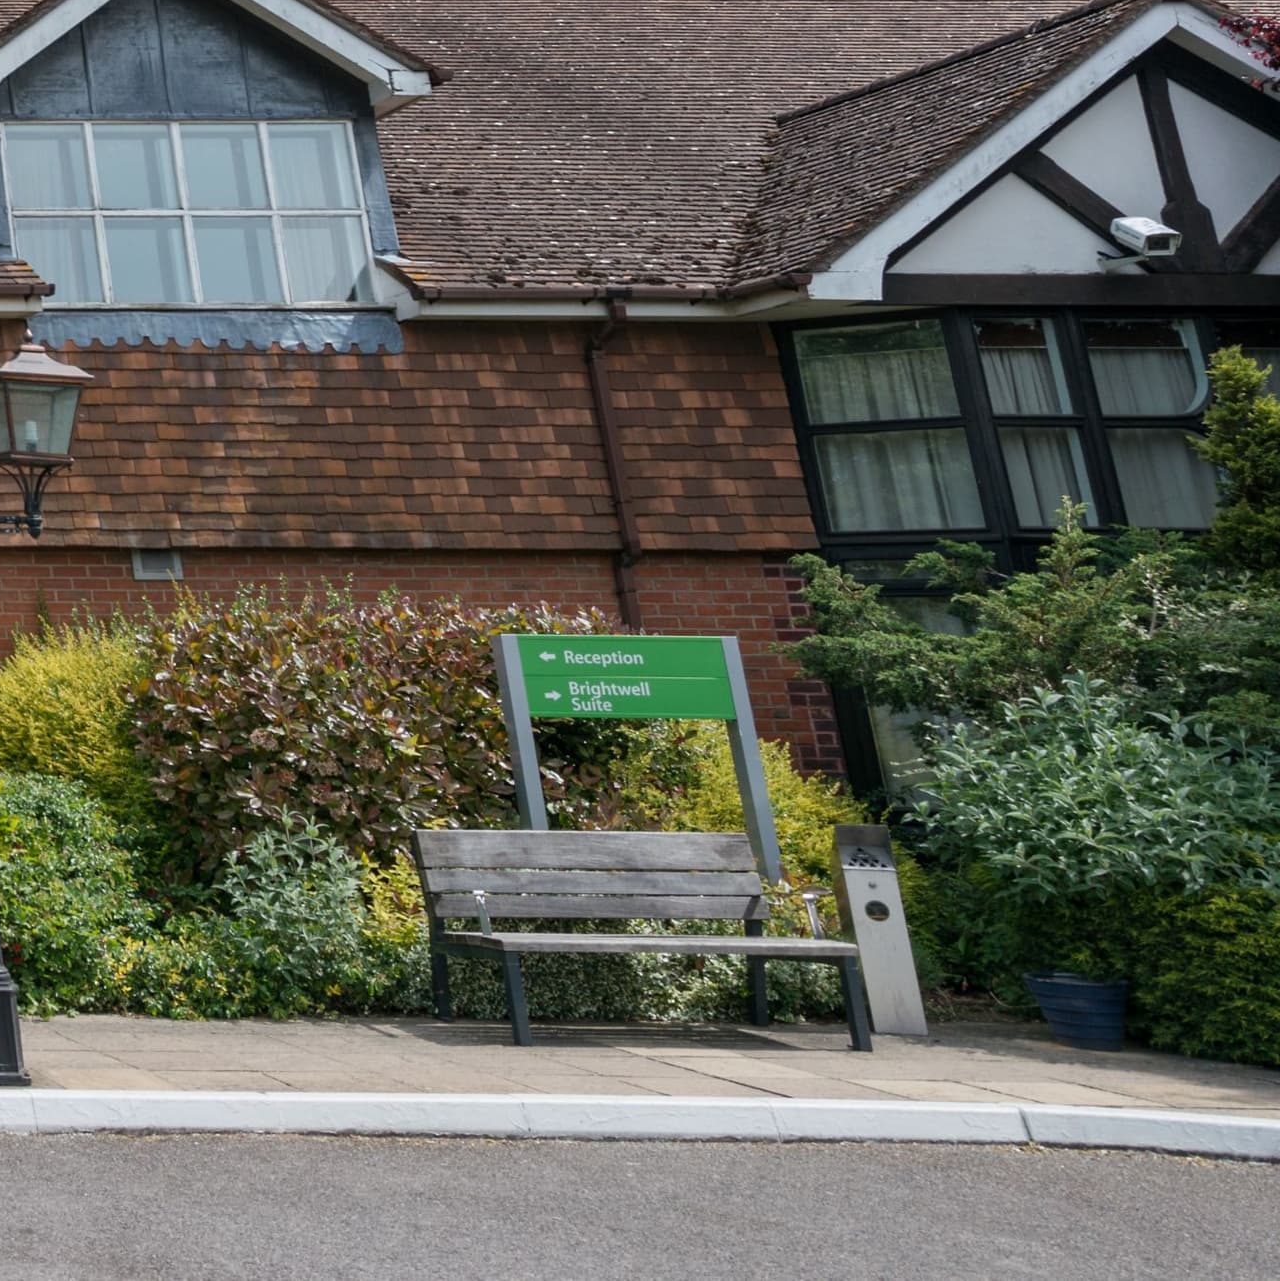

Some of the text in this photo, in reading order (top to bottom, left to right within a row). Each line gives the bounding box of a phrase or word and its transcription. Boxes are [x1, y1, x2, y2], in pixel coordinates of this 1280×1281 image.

[563, 650, 644, 668] Reception
[568, 681, 651, 699] Brightwell
[571, 697, 613, 712] Suite
